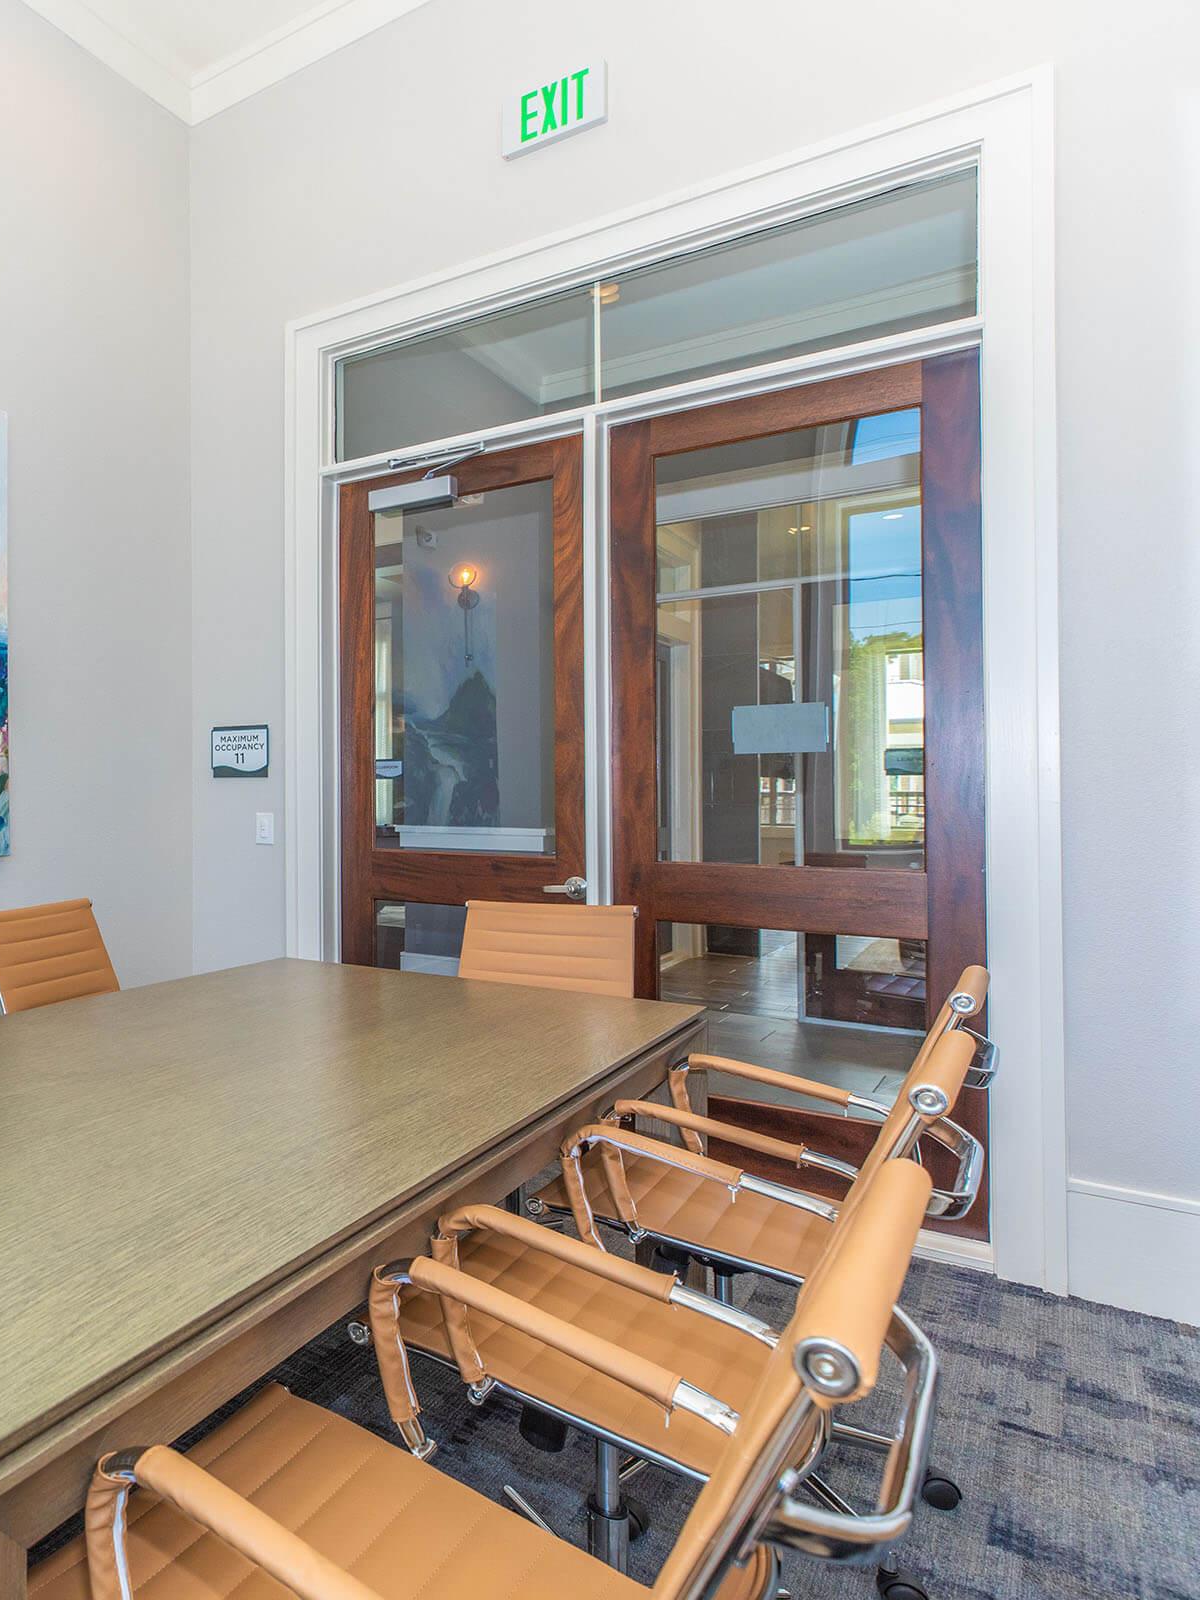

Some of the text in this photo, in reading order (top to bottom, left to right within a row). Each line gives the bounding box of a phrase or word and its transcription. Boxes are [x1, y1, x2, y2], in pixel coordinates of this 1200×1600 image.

[521, 67, 590, 143] EXIT
[220, 735, 259, 743] MAXIMUM
[214, 743, 265, 752] OCCUPANCY
[234, 752, 245, 764] 11
